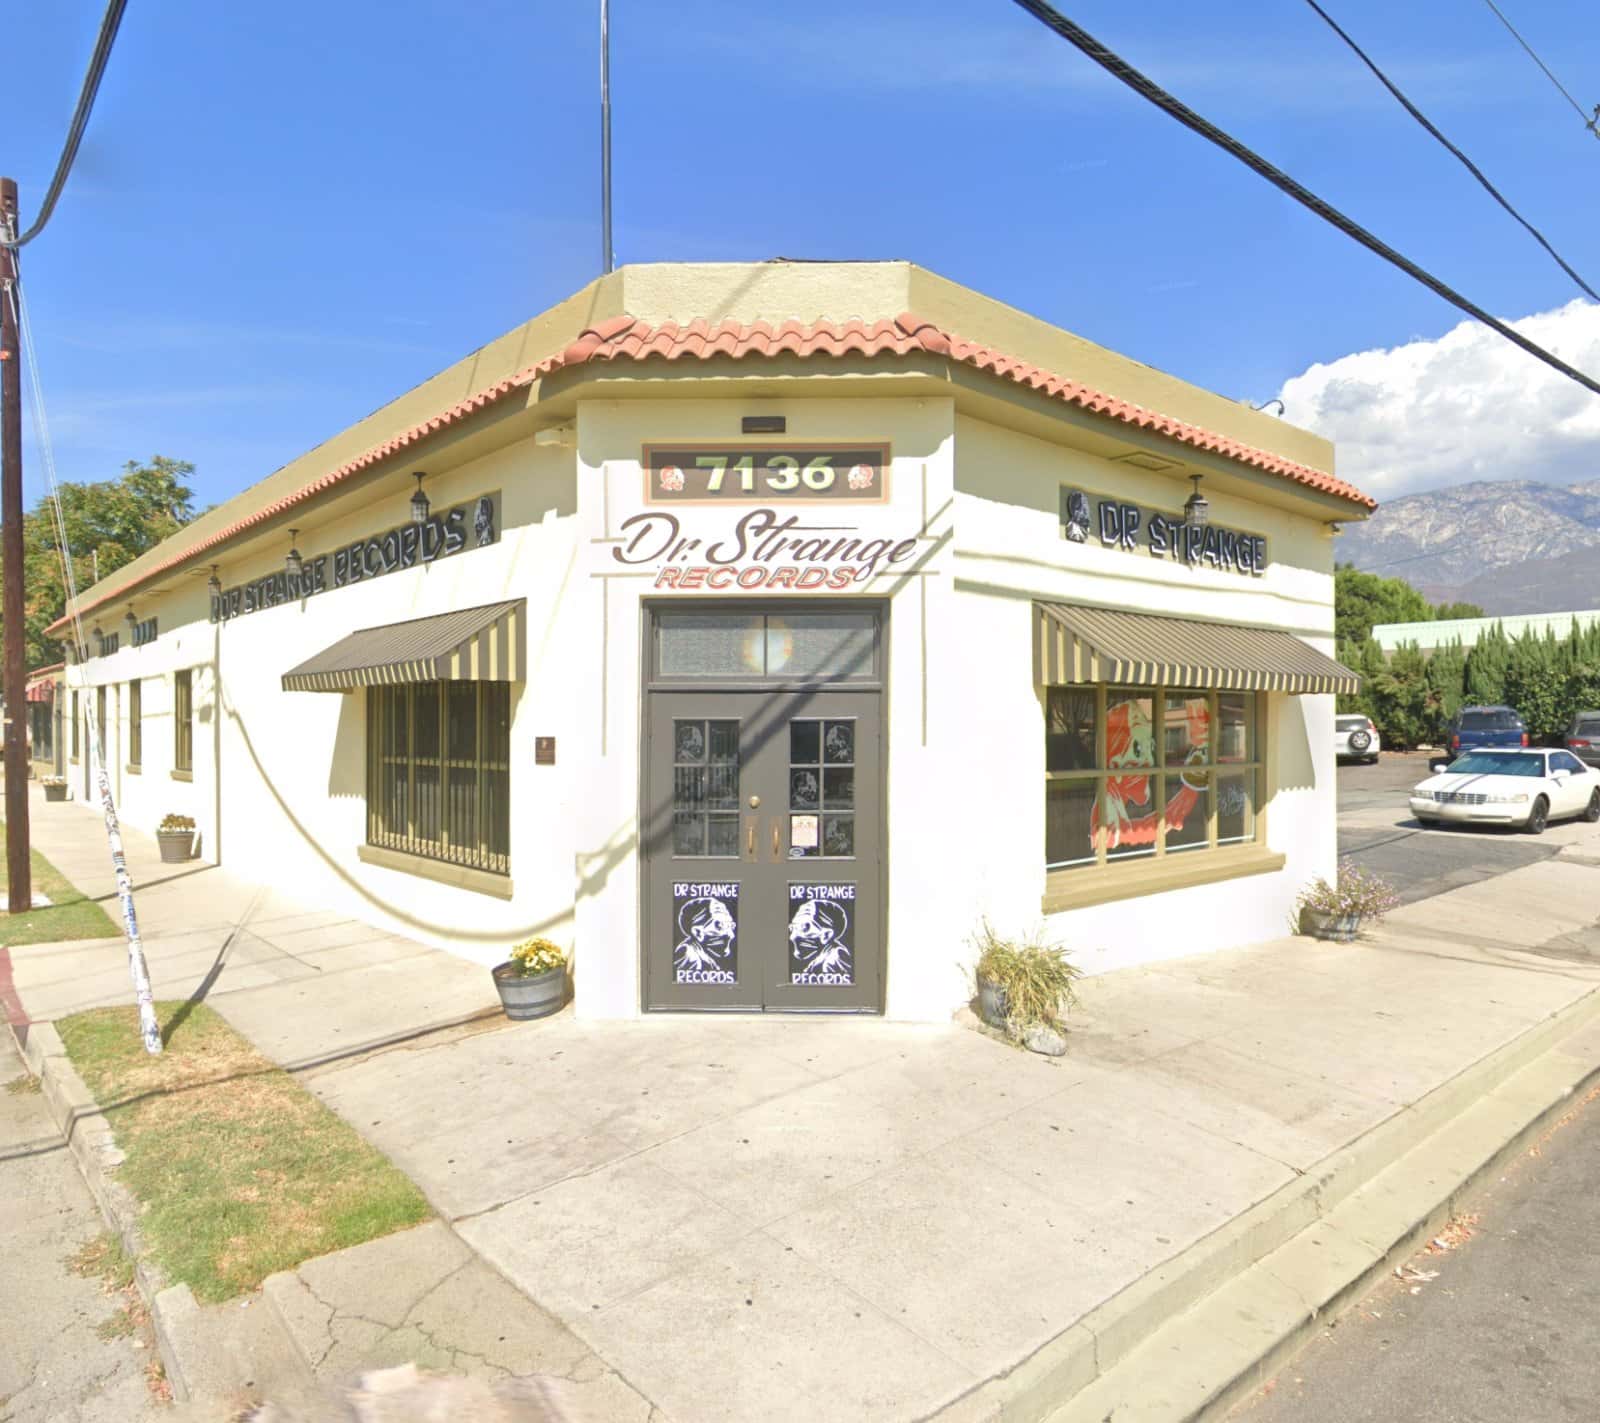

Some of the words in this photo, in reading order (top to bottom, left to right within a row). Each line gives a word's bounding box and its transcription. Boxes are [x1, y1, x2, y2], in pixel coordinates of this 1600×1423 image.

[695, 455, 836, 492] 7136
[612, 512, 702, 565] Dr.
[705, 508, 921, 583] Strange
[1098, 501, 1141, 551] DR
[1149, 513, 1266, 577] STRANGE
[244, 557, 327, 614] STRANGE
[333, 508, 467, 587] RECORDS
[654, 565, 858, 590] RECORDS
[674, 883, 689, 897] DR
[690, 883, 738, 898] STRANGE
[790, 886, 805, 899] DR
[806, 885, 856, 899] STRANGE
[676, 970, 735, 984] RECORDS
[792, 972, 852, 985] RECORDS
